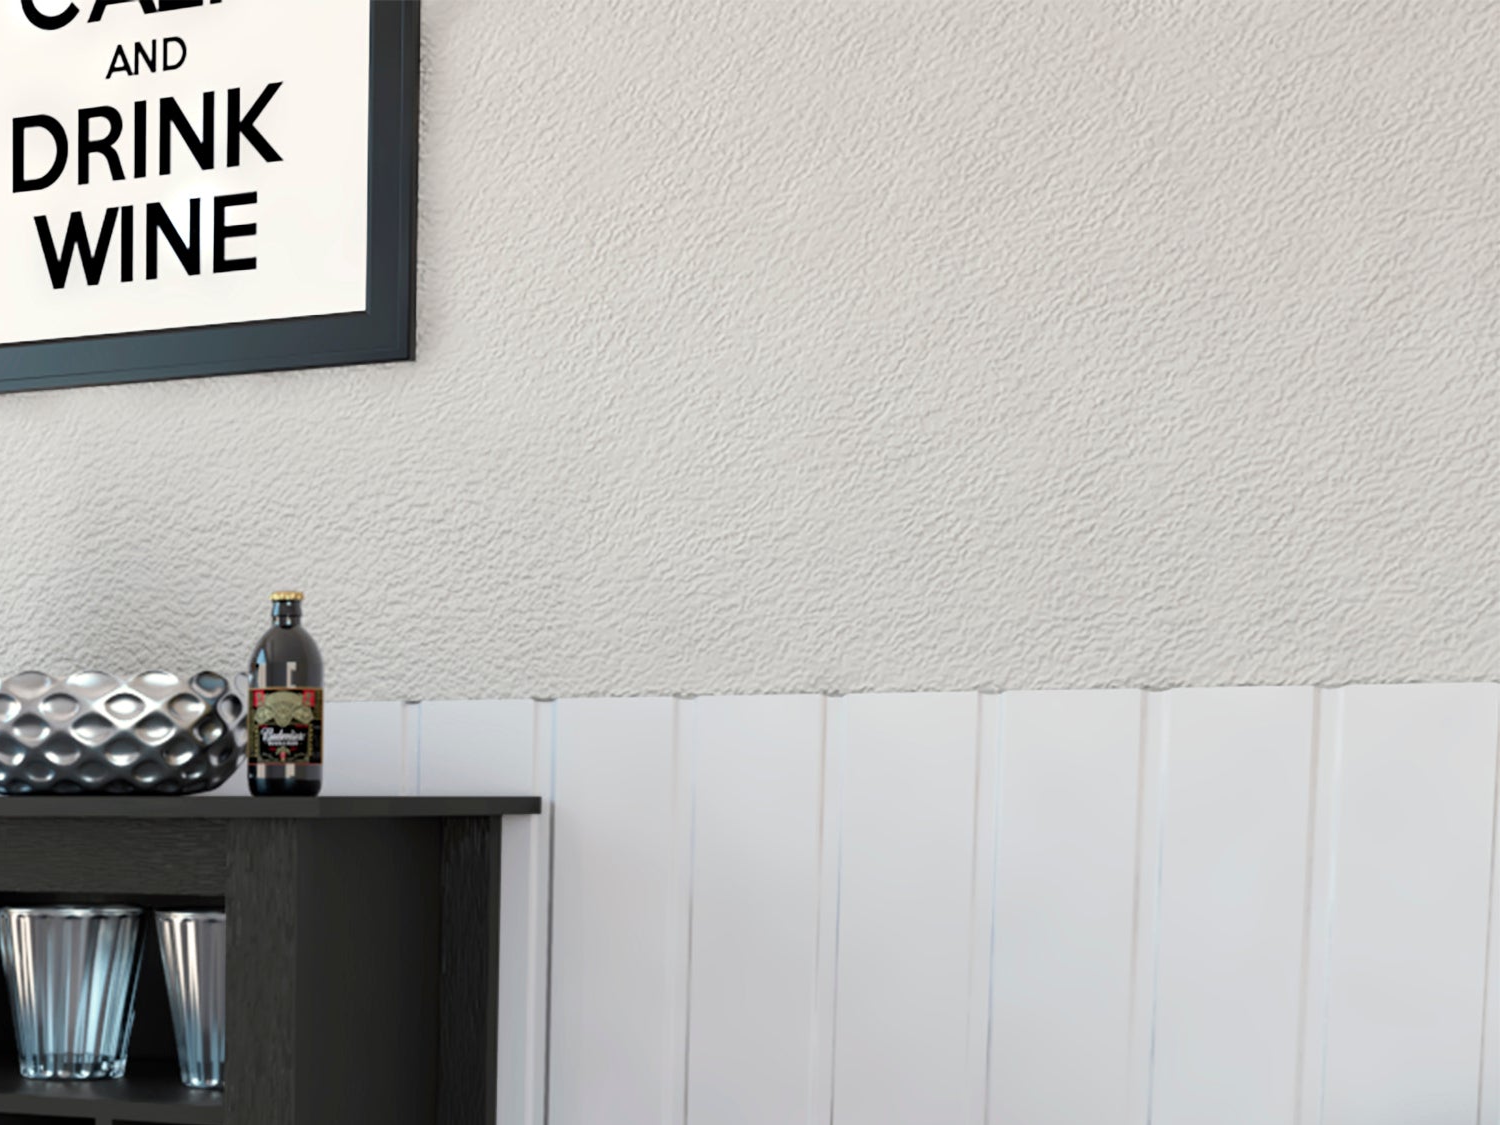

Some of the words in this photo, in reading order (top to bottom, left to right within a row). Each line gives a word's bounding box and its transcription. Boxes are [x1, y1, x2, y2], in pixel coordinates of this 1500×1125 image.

[105, 36, 188, 80] AND
[11, 81, 284, 193] DRINK
[34, 191, 258, 290] WINE
